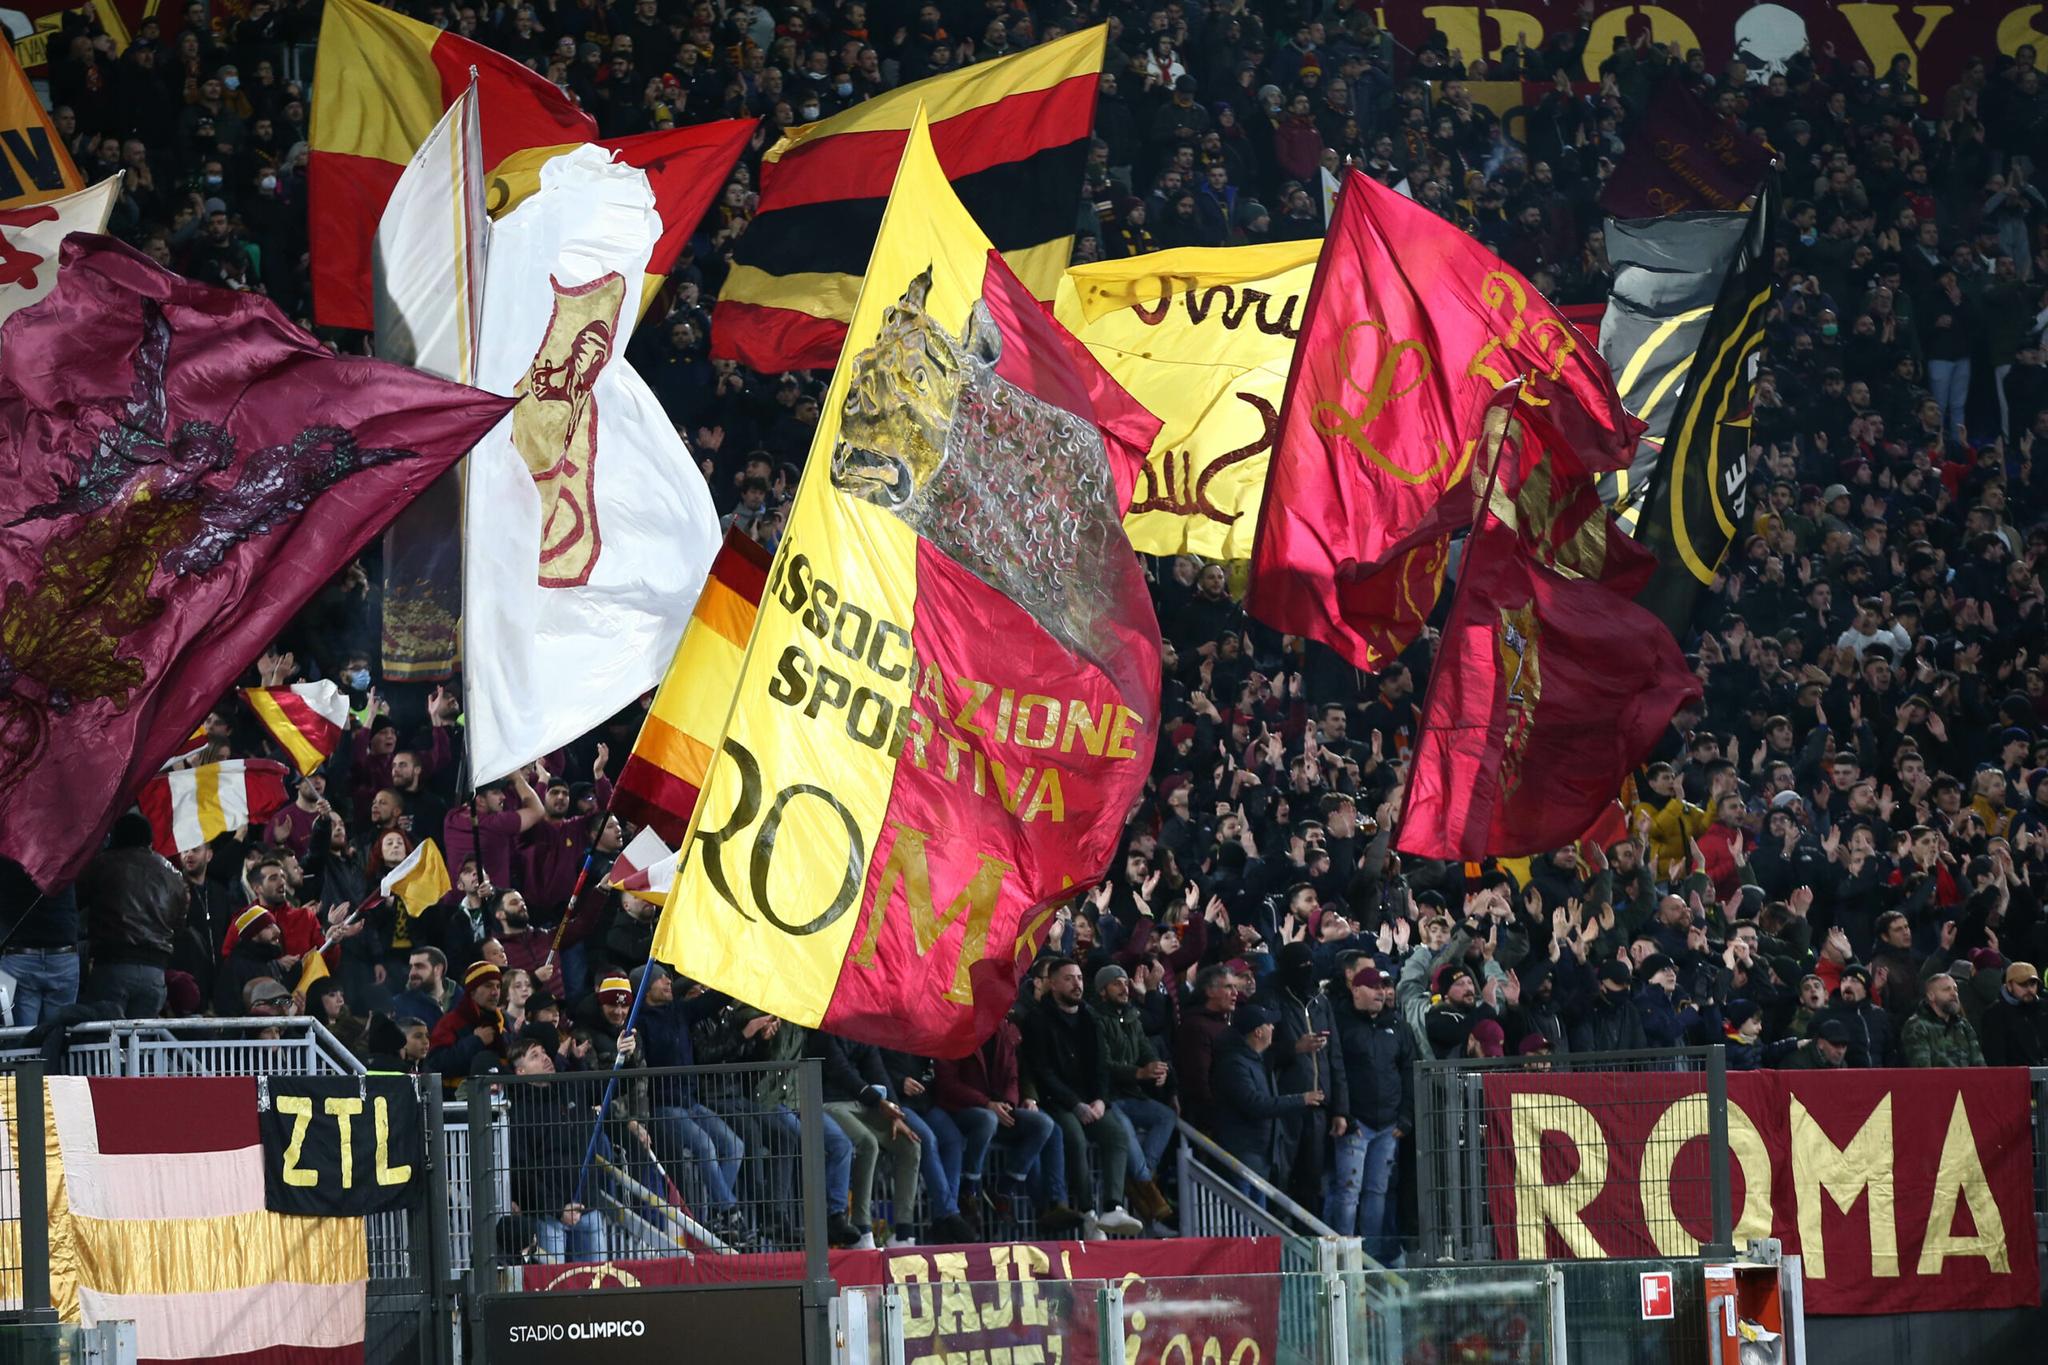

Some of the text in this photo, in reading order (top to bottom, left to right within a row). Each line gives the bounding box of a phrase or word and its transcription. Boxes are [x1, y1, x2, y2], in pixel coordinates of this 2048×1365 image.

[768, 645, 1065, 823] SPORTIVA
[276, 1095, 412, 1189] ZTL
[1510, 1089, 2012, 1280] ROMA
[509, 1320, 645, 1343] STADIO OLIMPICO
